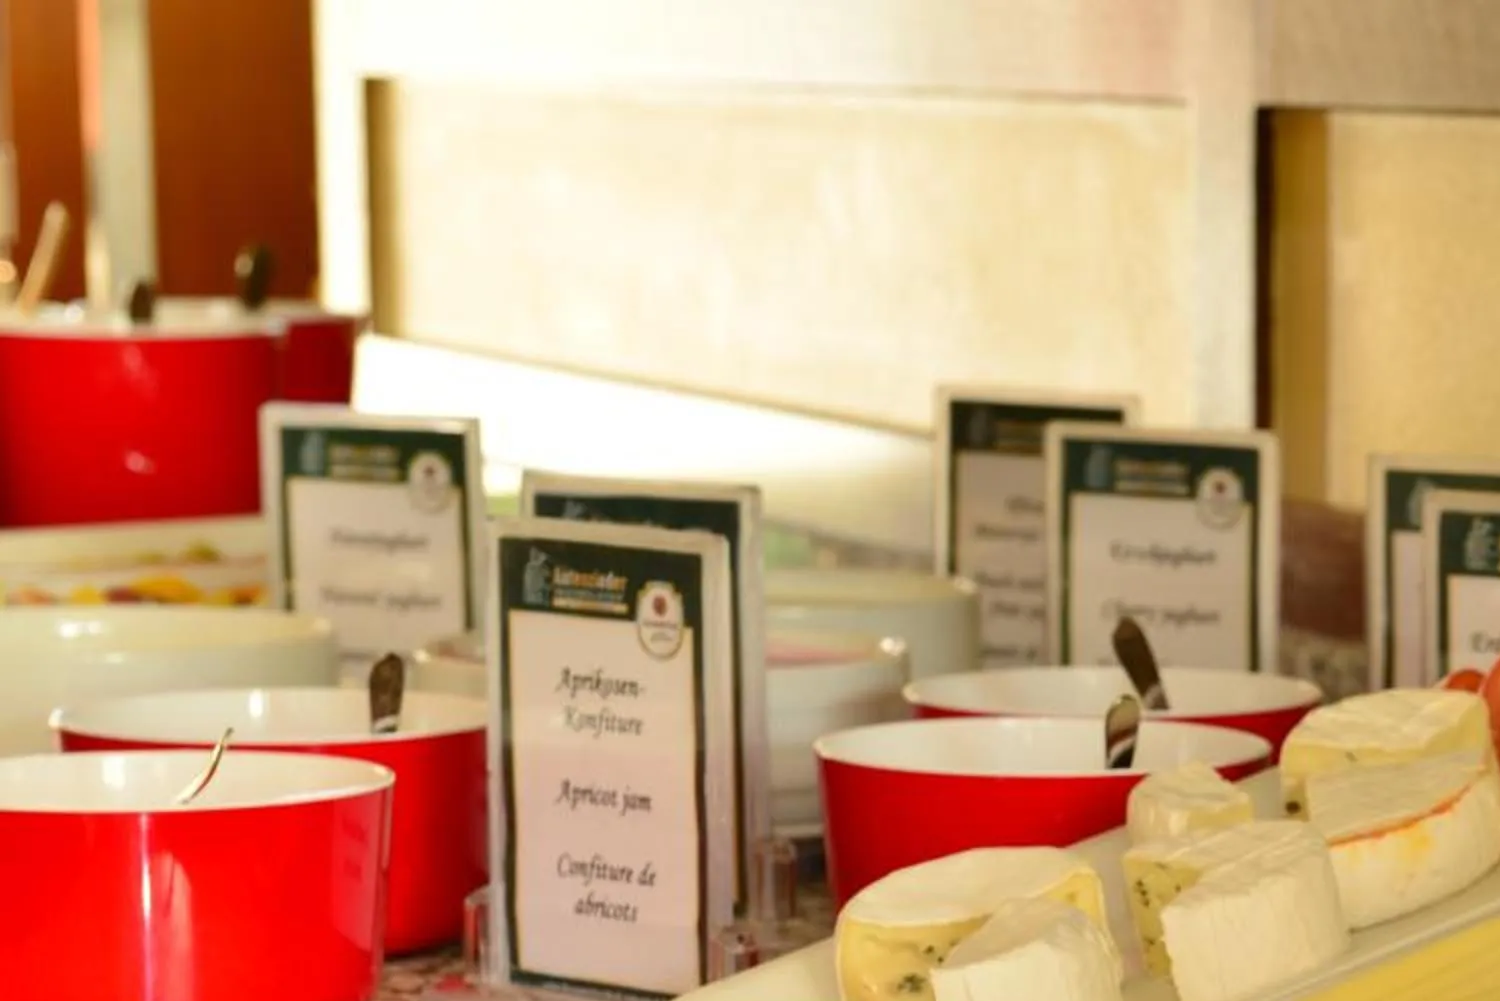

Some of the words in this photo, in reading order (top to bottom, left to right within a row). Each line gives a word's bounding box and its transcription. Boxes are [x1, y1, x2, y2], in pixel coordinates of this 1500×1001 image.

[554, 666, 646, 699] Aprikosen-
[554, 778, 617, 811] Apricot
[619, 785, 652, 817] jam
[557, 851, 634, 887] Confiture
[637, 861, 656, 887] de
[574, 890, 638, 922] abricots
